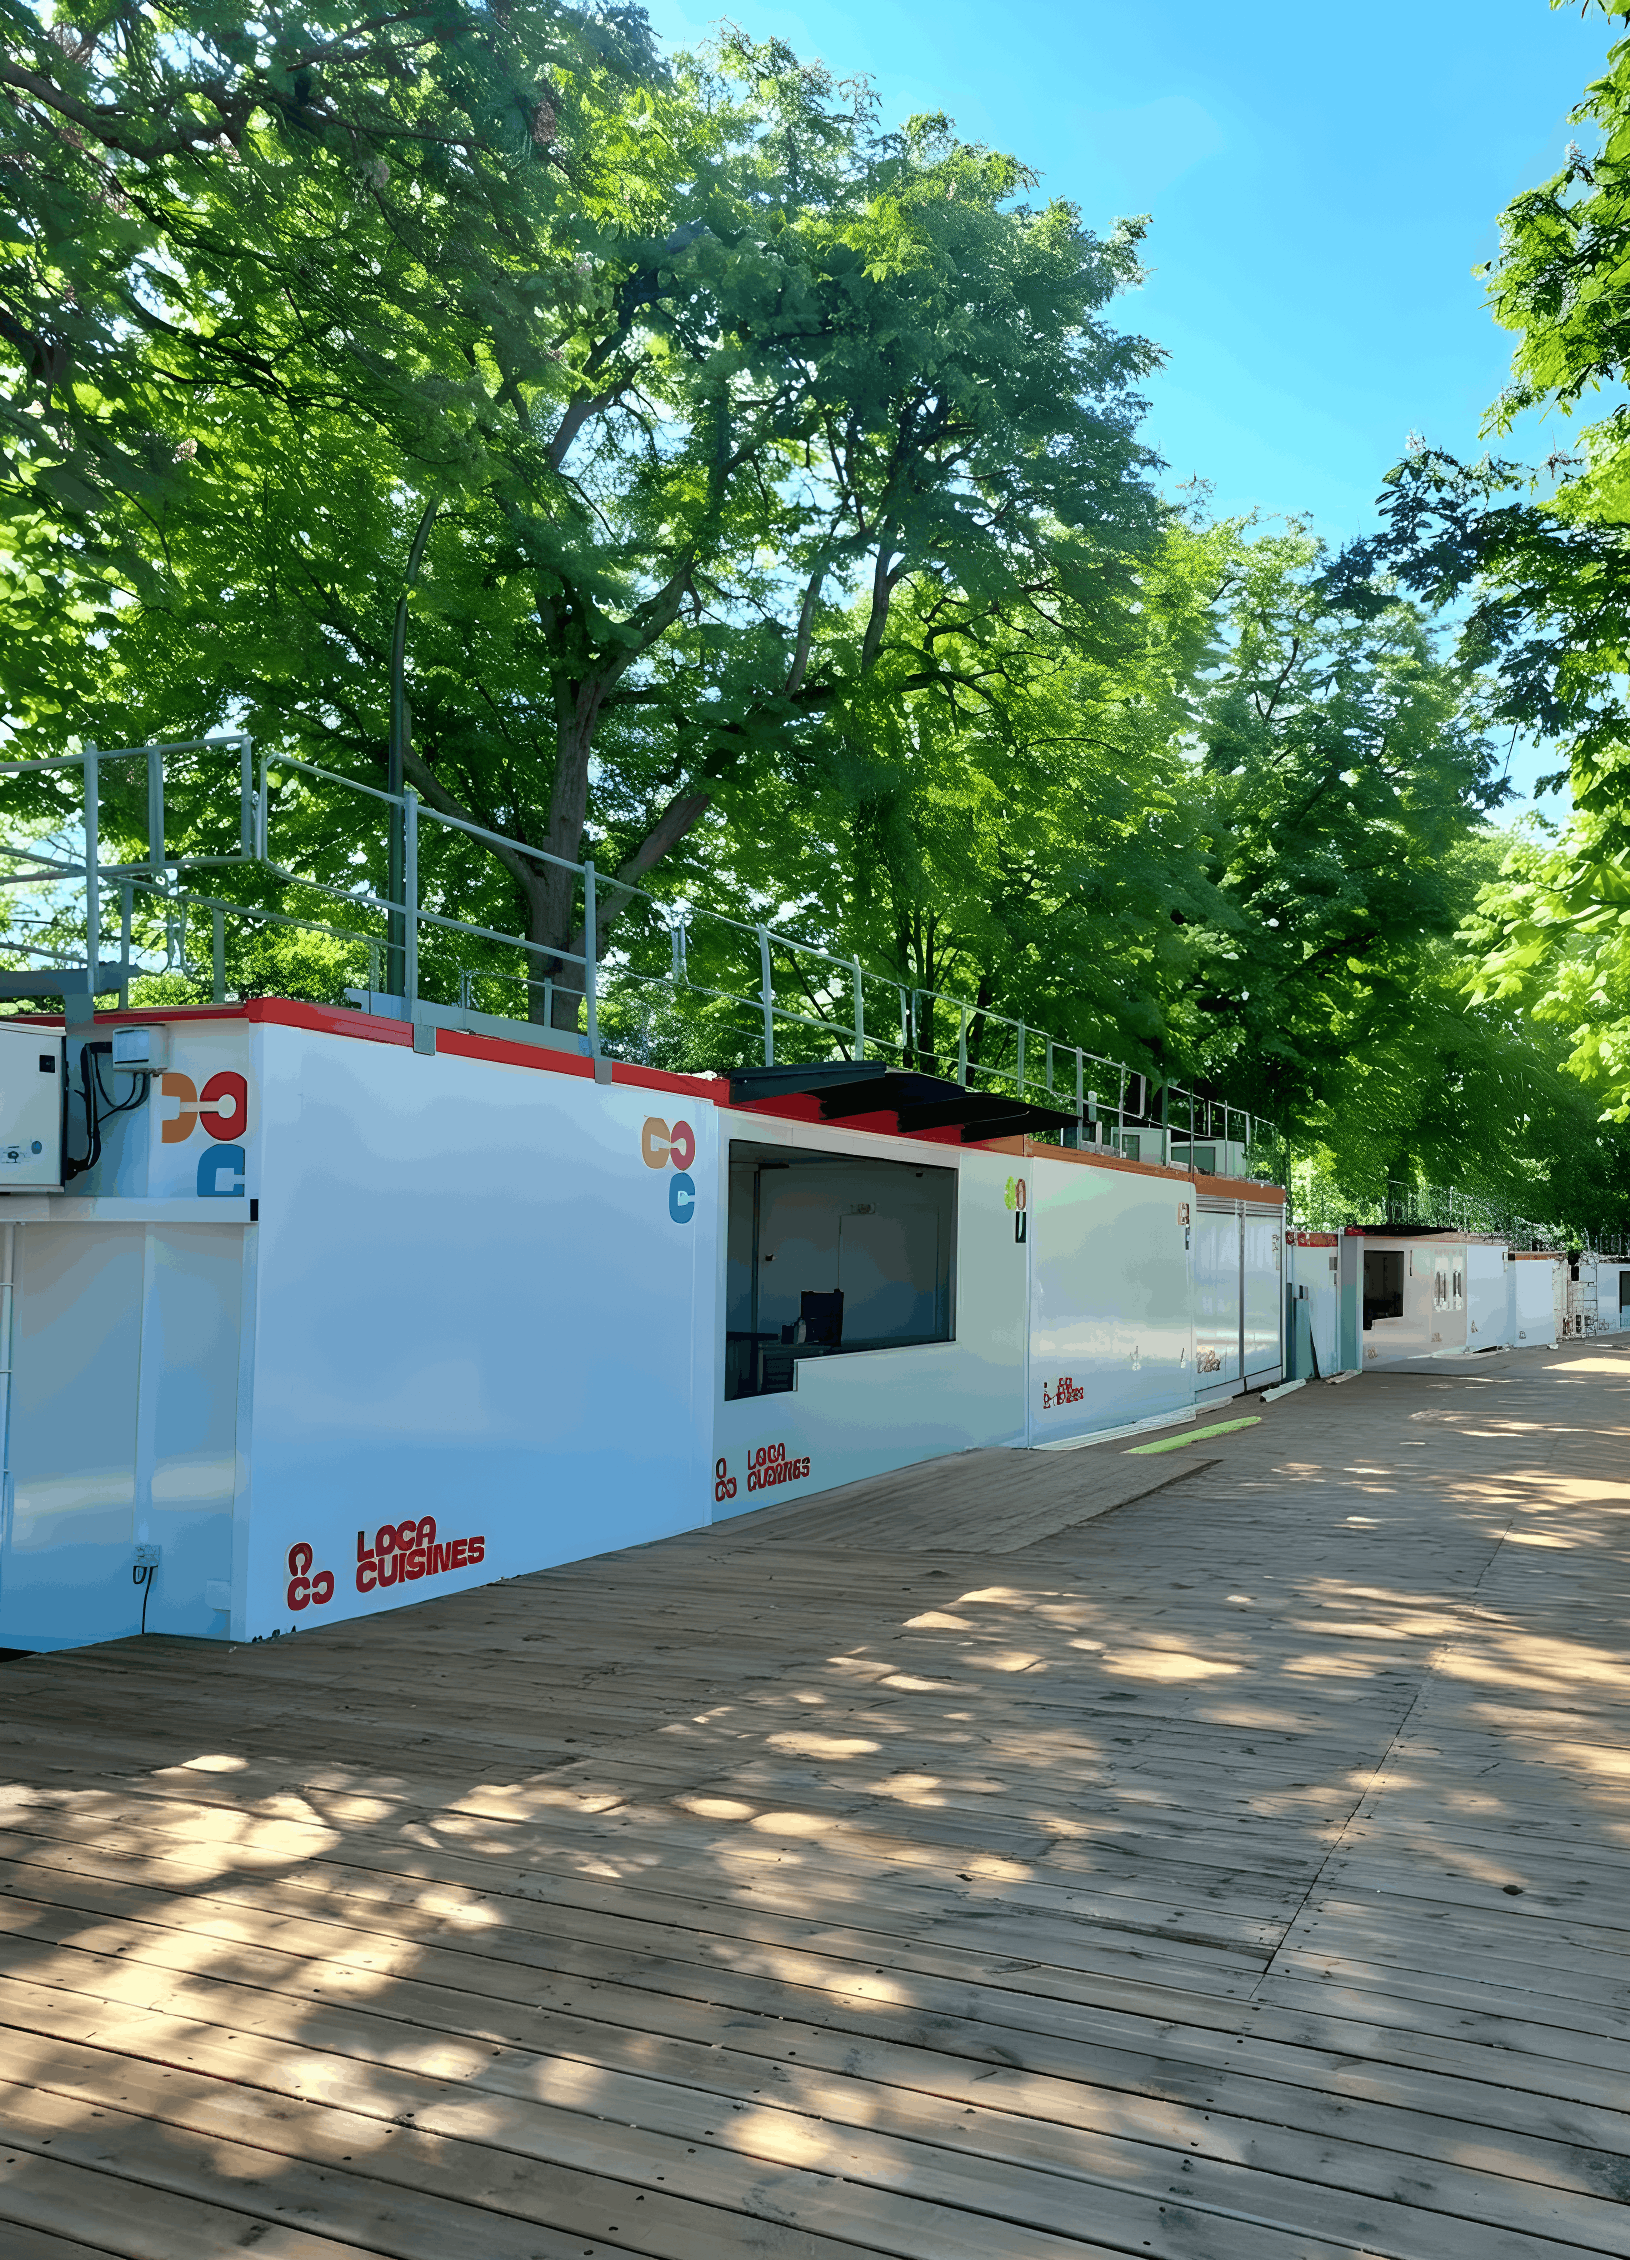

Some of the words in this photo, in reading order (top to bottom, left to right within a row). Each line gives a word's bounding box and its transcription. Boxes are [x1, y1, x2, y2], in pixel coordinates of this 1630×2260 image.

[747, 1442, 786, 1471] LOCA
[356, 1515, 437, 1563] LOCA
[355, 1535, 486, 1593] CUISINES
